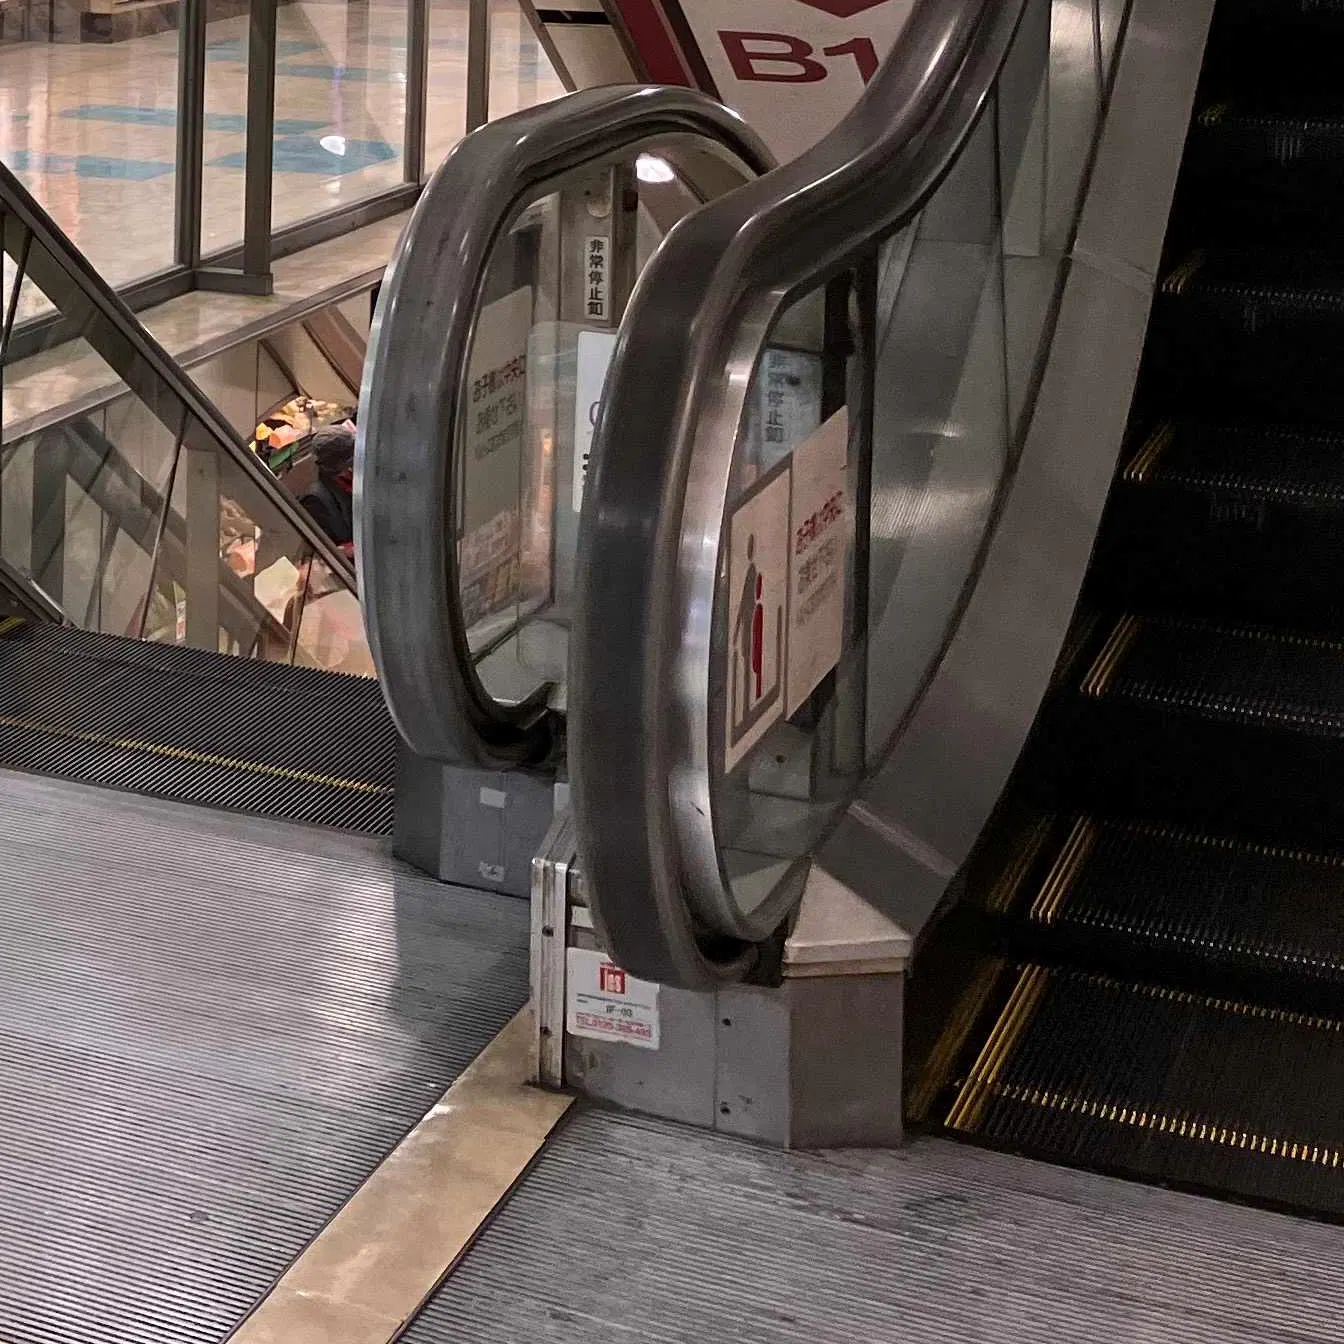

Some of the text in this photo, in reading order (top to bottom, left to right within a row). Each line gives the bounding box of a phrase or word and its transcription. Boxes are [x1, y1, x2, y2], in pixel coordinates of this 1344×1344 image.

[717, 30, 879, 86] B1
[588, 239, 605, 316] 非常停止釦
